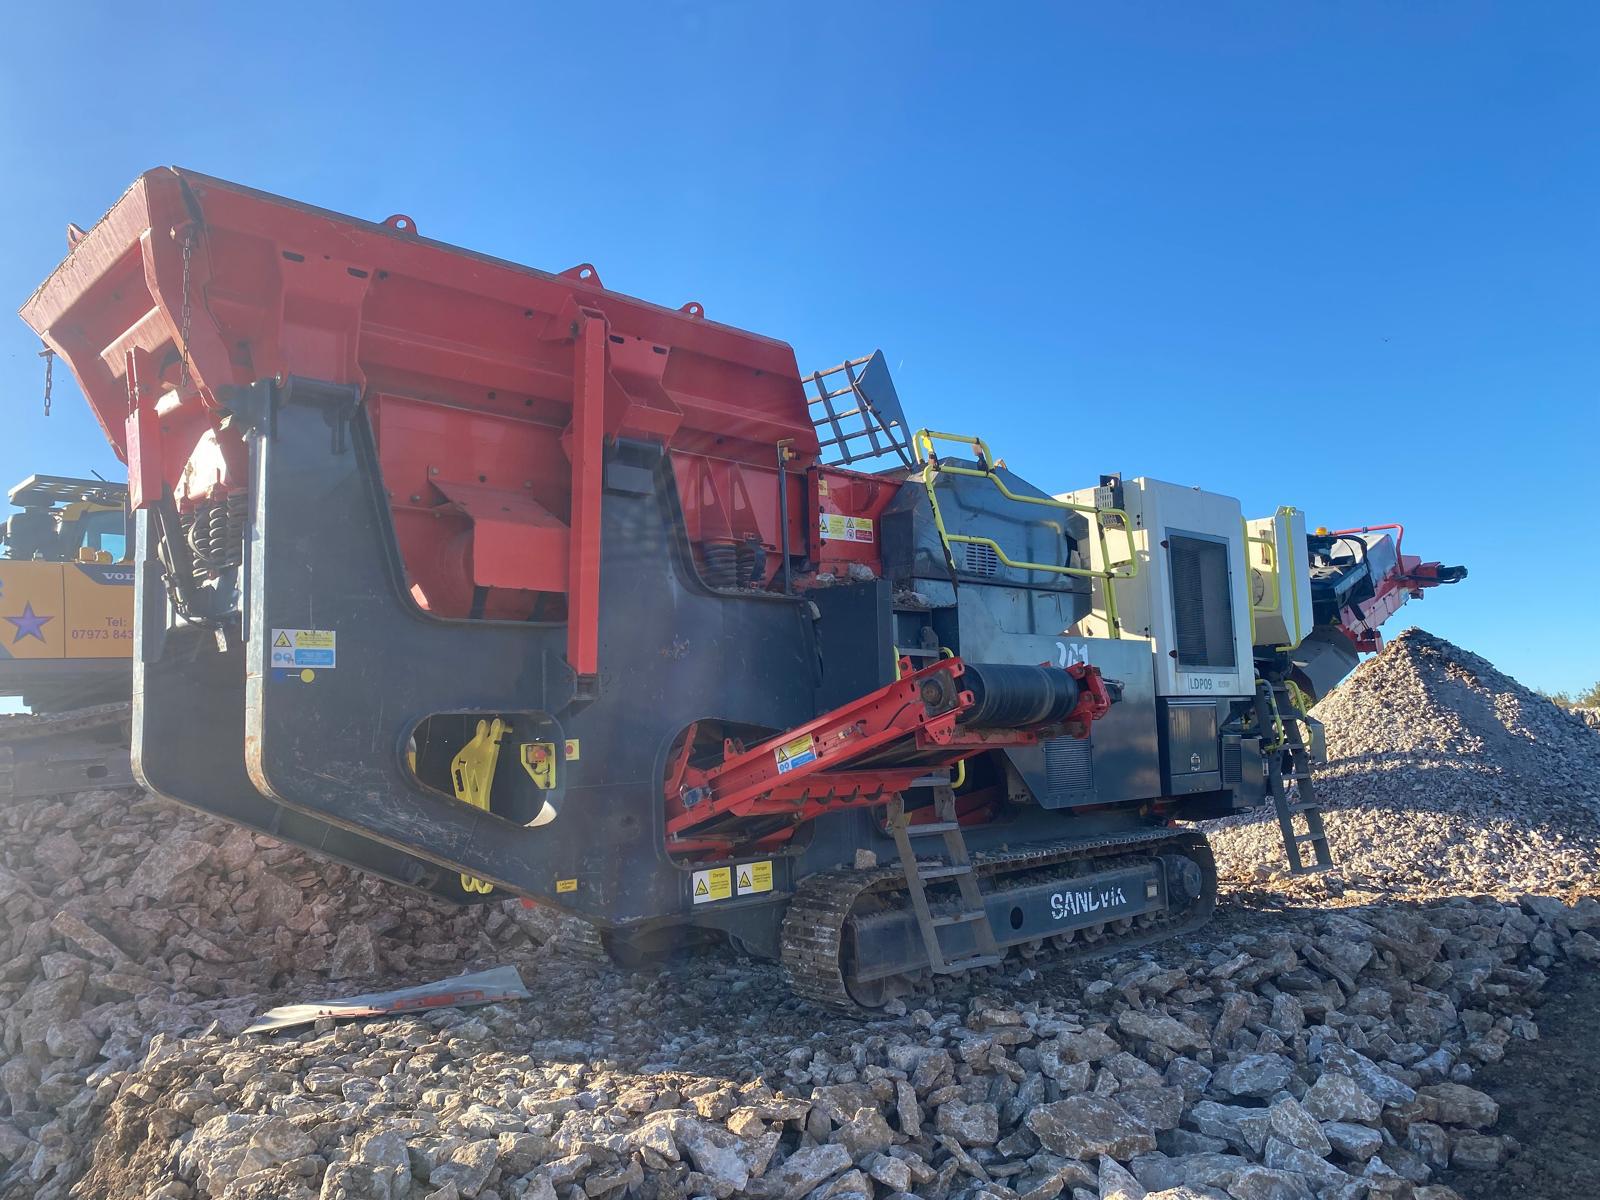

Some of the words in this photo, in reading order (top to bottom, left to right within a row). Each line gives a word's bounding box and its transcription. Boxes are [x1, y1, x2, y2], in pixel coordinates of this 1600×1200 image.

[105, 616, 127, 627] Tel:
[71, 629, 109, 639] 07973
[1189, 678, 1213, 690] LDP09
